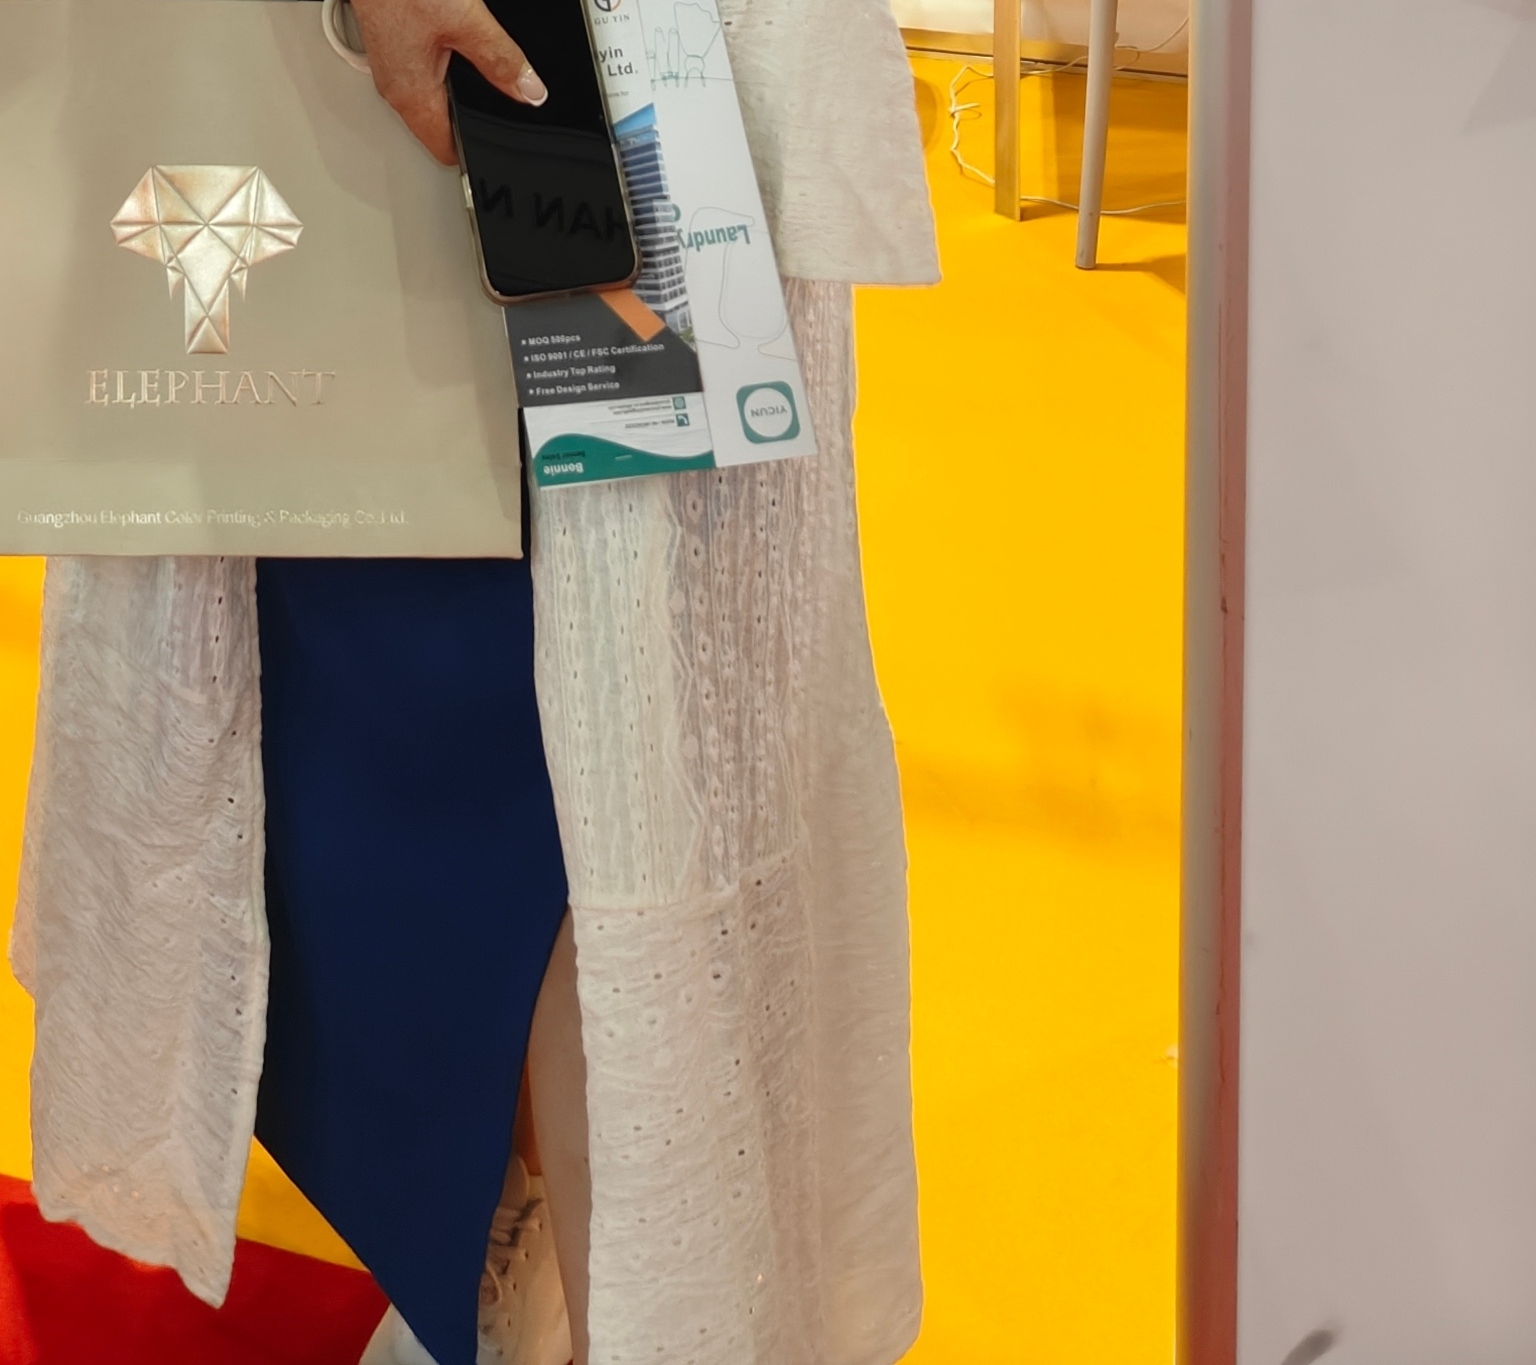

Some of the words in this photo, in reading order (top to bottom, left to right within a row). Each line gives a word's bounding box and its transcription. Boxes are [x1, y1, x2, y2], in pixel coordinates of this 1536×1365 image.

[598, 46, 624, 63] yin
[607, 62, 638, 77] Ltd.
[528, 336, 549, 345] MOQ
[531, 353, 546, 362] ISO
[573, 349, 585, 358] CE
[592, 347, 609, 356] FSC
[612, 343, 664, 354] Certification
[533, 369, 569, 379] Industry
[571, 367, 585, 376] Top
[587, 365, 616, 374] Rating
[84, 368, 335, 408] ELEPHANT
[536, 387, 555, 395] Free
[556, 384, 586, 394] Design
[588, 381, 620, 390] Service
[543, 462, 584, 476] Bonnie
[17, 510, 98, 526] Guangzhou
[100, 510, 162, 526] Elephant
[165, 510, 203, 524] Color
[206, 509, 261, 526] Printing
[279, 510, 351, 526] Packaging
